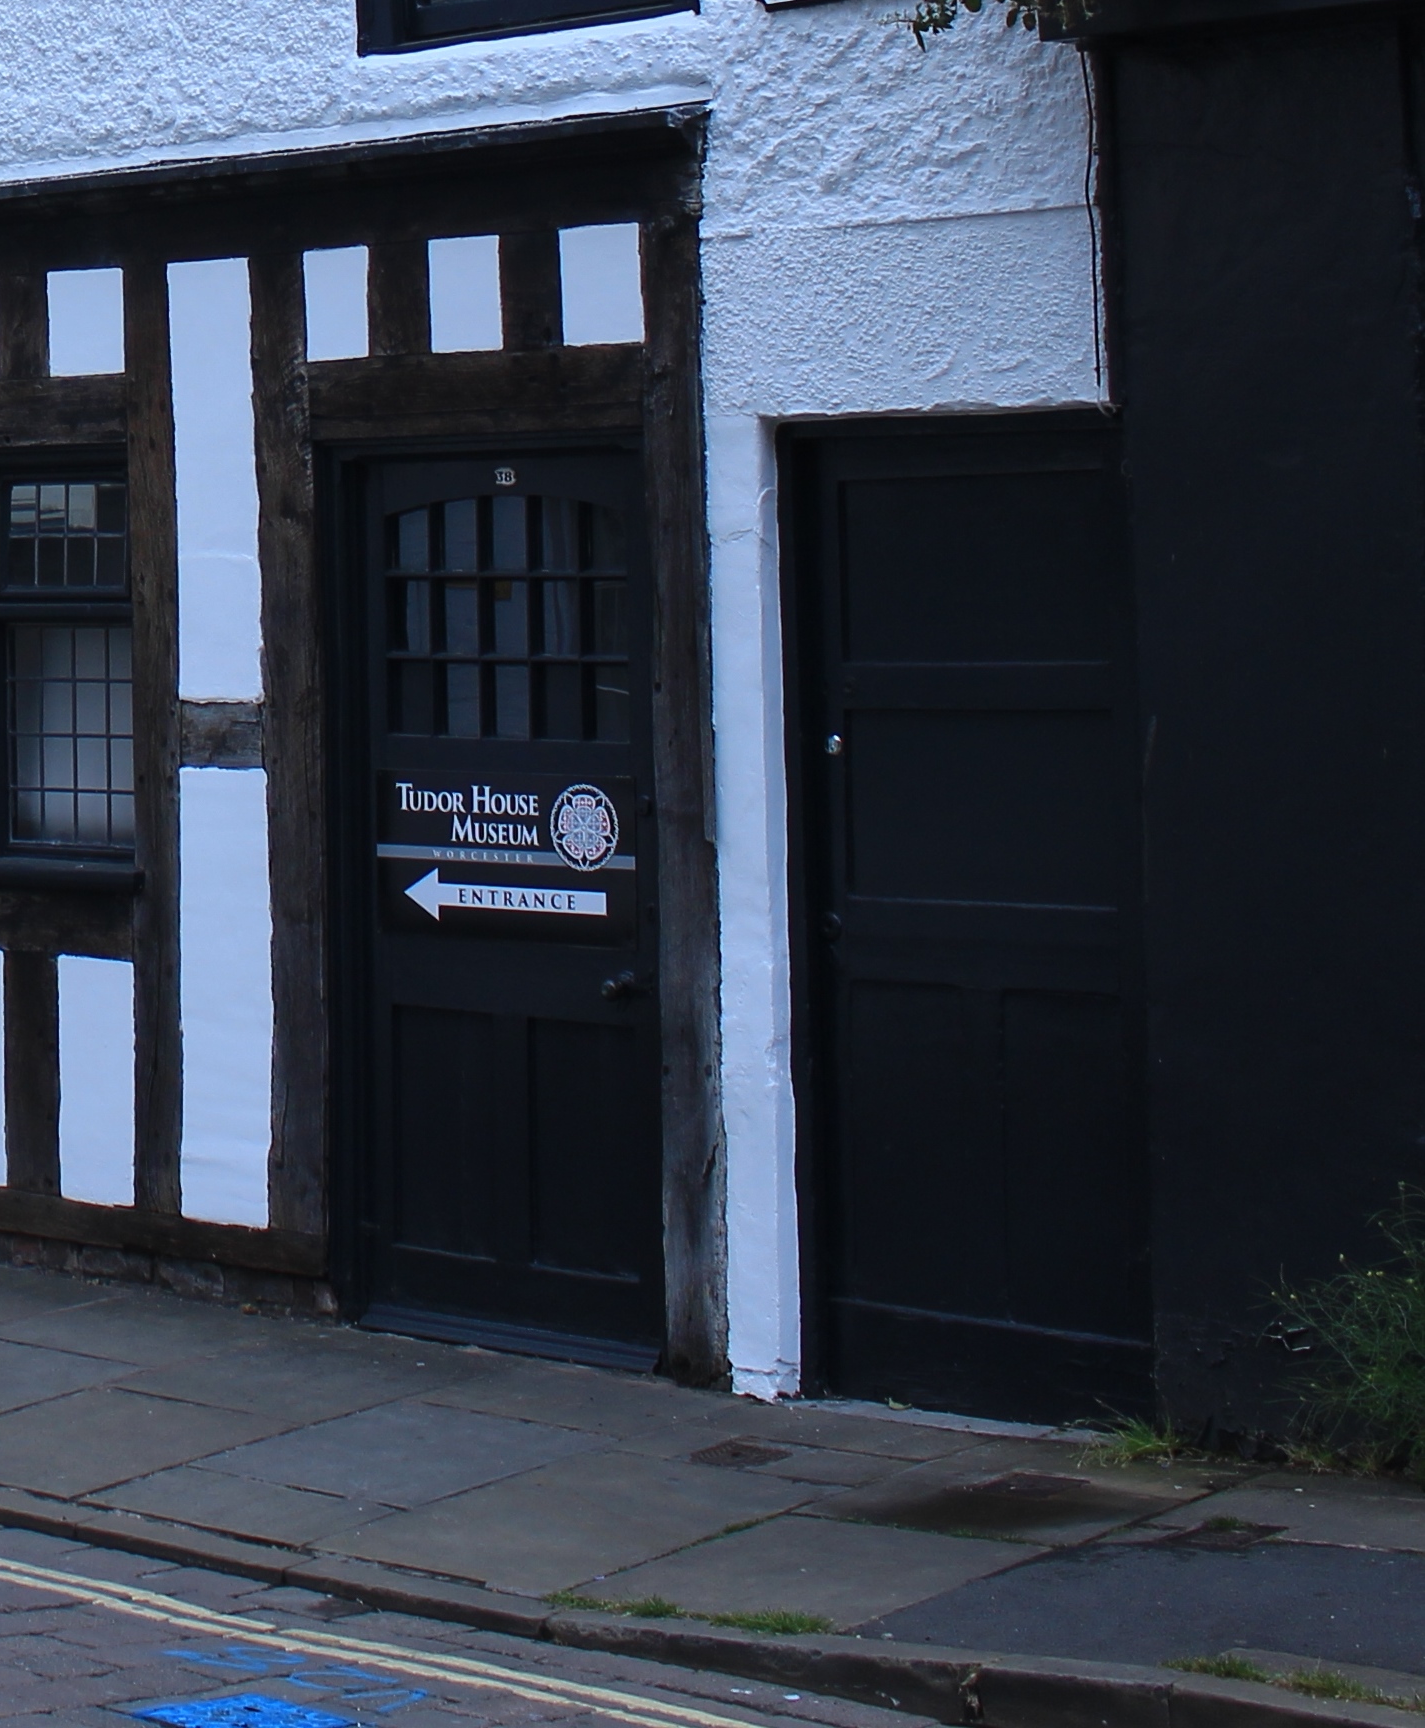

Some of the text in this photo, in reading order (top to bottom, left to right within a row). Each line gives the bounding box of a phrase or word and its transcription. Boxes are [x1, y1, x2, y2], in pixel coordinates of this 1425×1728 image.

[495, 468, 515, 485] 38
[395, 782, 540, 817] TUDOR HOUSE
[451, 814, 541, 847] MUSEUM
[432, 849, 535, 864] WORCESTER
[458, 888, 577, 911] ENTRANCE
